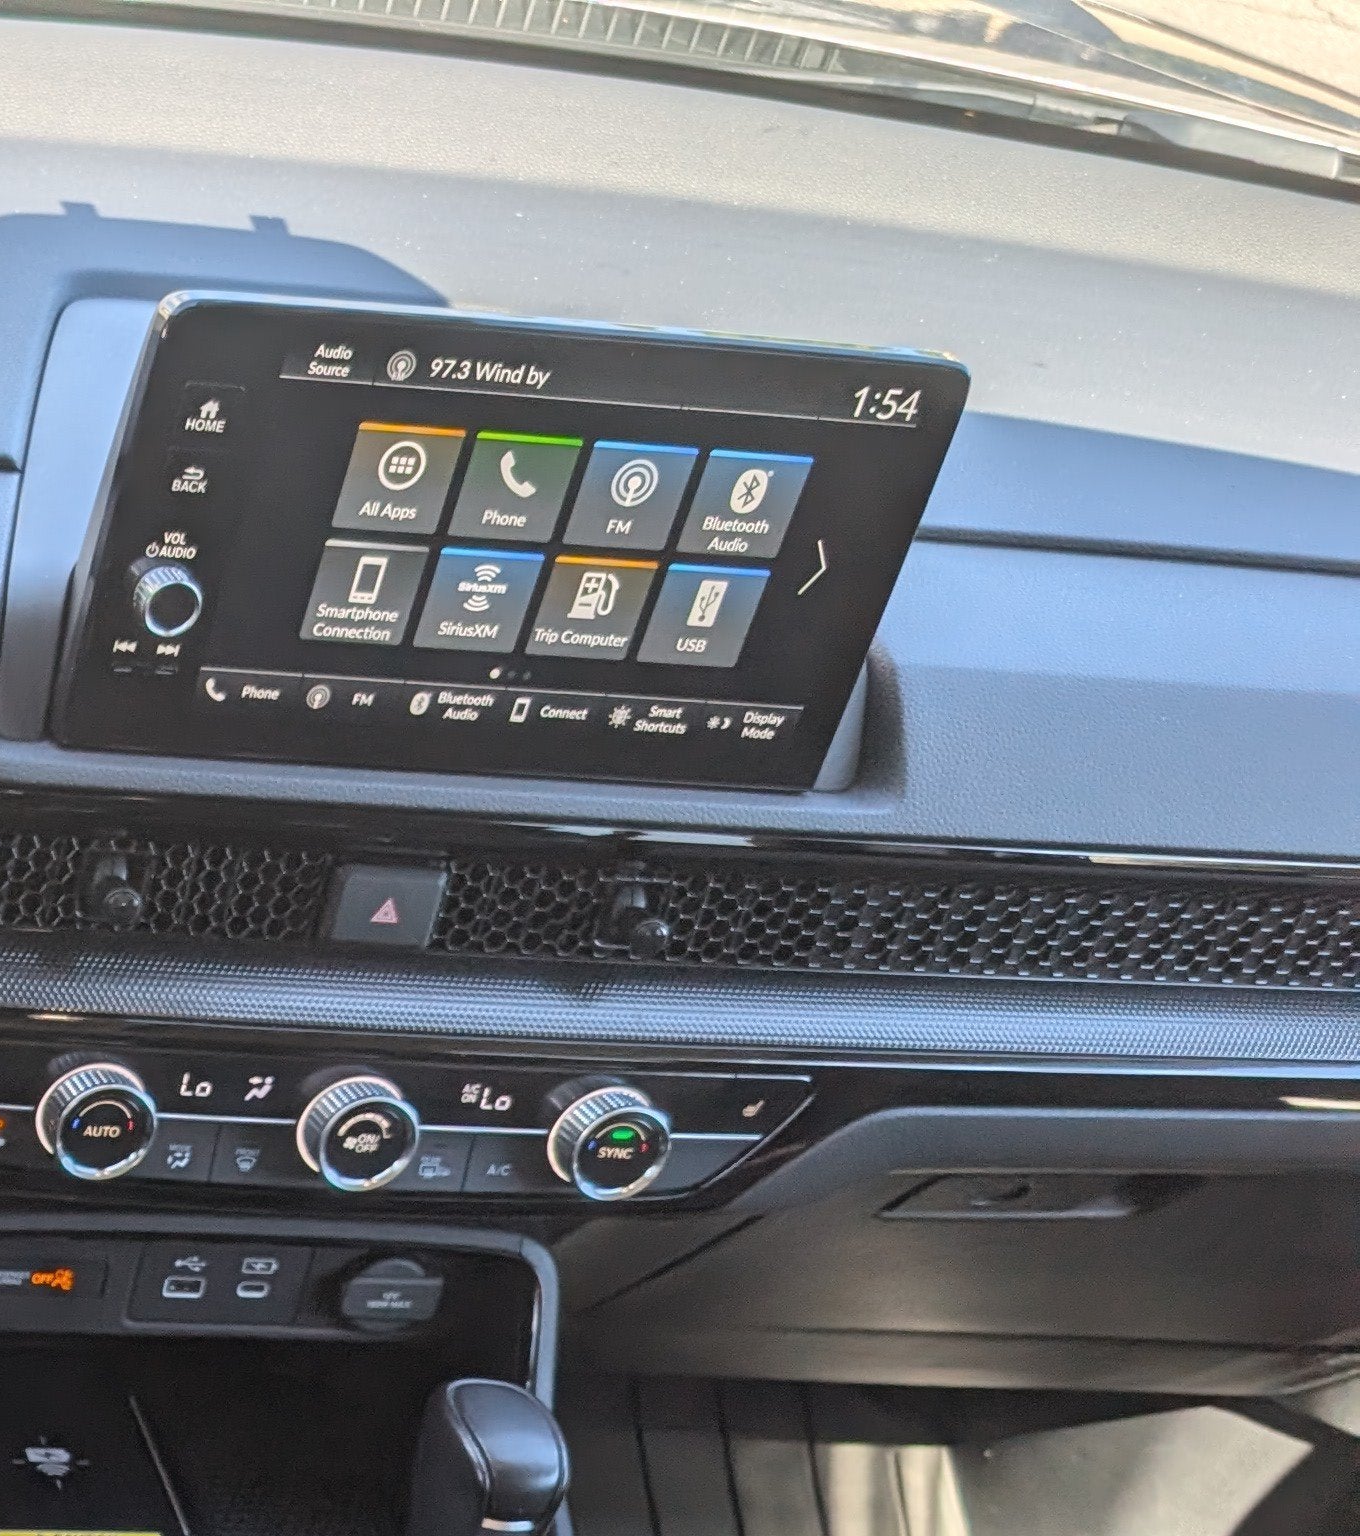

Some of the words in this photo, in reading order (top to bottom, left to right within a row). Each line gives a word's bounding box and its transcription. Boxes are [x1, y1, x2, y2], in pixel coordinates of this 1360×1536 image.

[314, 343, 353, 360] Audio
[307, 362, 350, 378] Source
[430, 359, 470, 380] 97.3
[475, 362, 523, 384] Wind
[526, 365, 551, 389] by
[853, 386, 922, 421] 1:54
[185, 418, 226, 433] HOME
[171, 479, 207, 493] BACK
[358, 500, 379, 517] All
[380, 503, 417, 521] Apps
[482, 509, 527, 528] Phone
[605, 518, 633, 535] FM
[702, 515, 769, 534] Bluetooth
[164, 531, 186, 546] VOL
[707, 537, 748, 553] Audio
[159, 546, 197, 560] AUDIO
[316, 603, 399, 623] Smartphone
[312, 621, 391, 642] Connection
[437, 620, 500, 640] SiriusXM
[534, 628, 559, 645] Trip
[561, 629, 628, 649] Computer
[675, 637, 708, 653] USB
[241, 684, 280, 701] Phone
[352, 692, 375, 707] FM
[437, 690, 495, 707] Bluetooth
[442, 707, 479, 722] Audio
[540, 704, 589, 721] Connect
[648, 704, 684, 720] Smart
[742, 710, 785, 728] Display
[633, 719, 688, 735] Shortcuts
[740, 726, 776, 741] Mode
[83, 1125, 121, 1138] AUTO
[596, 1146, 634, 1160] SYNC
